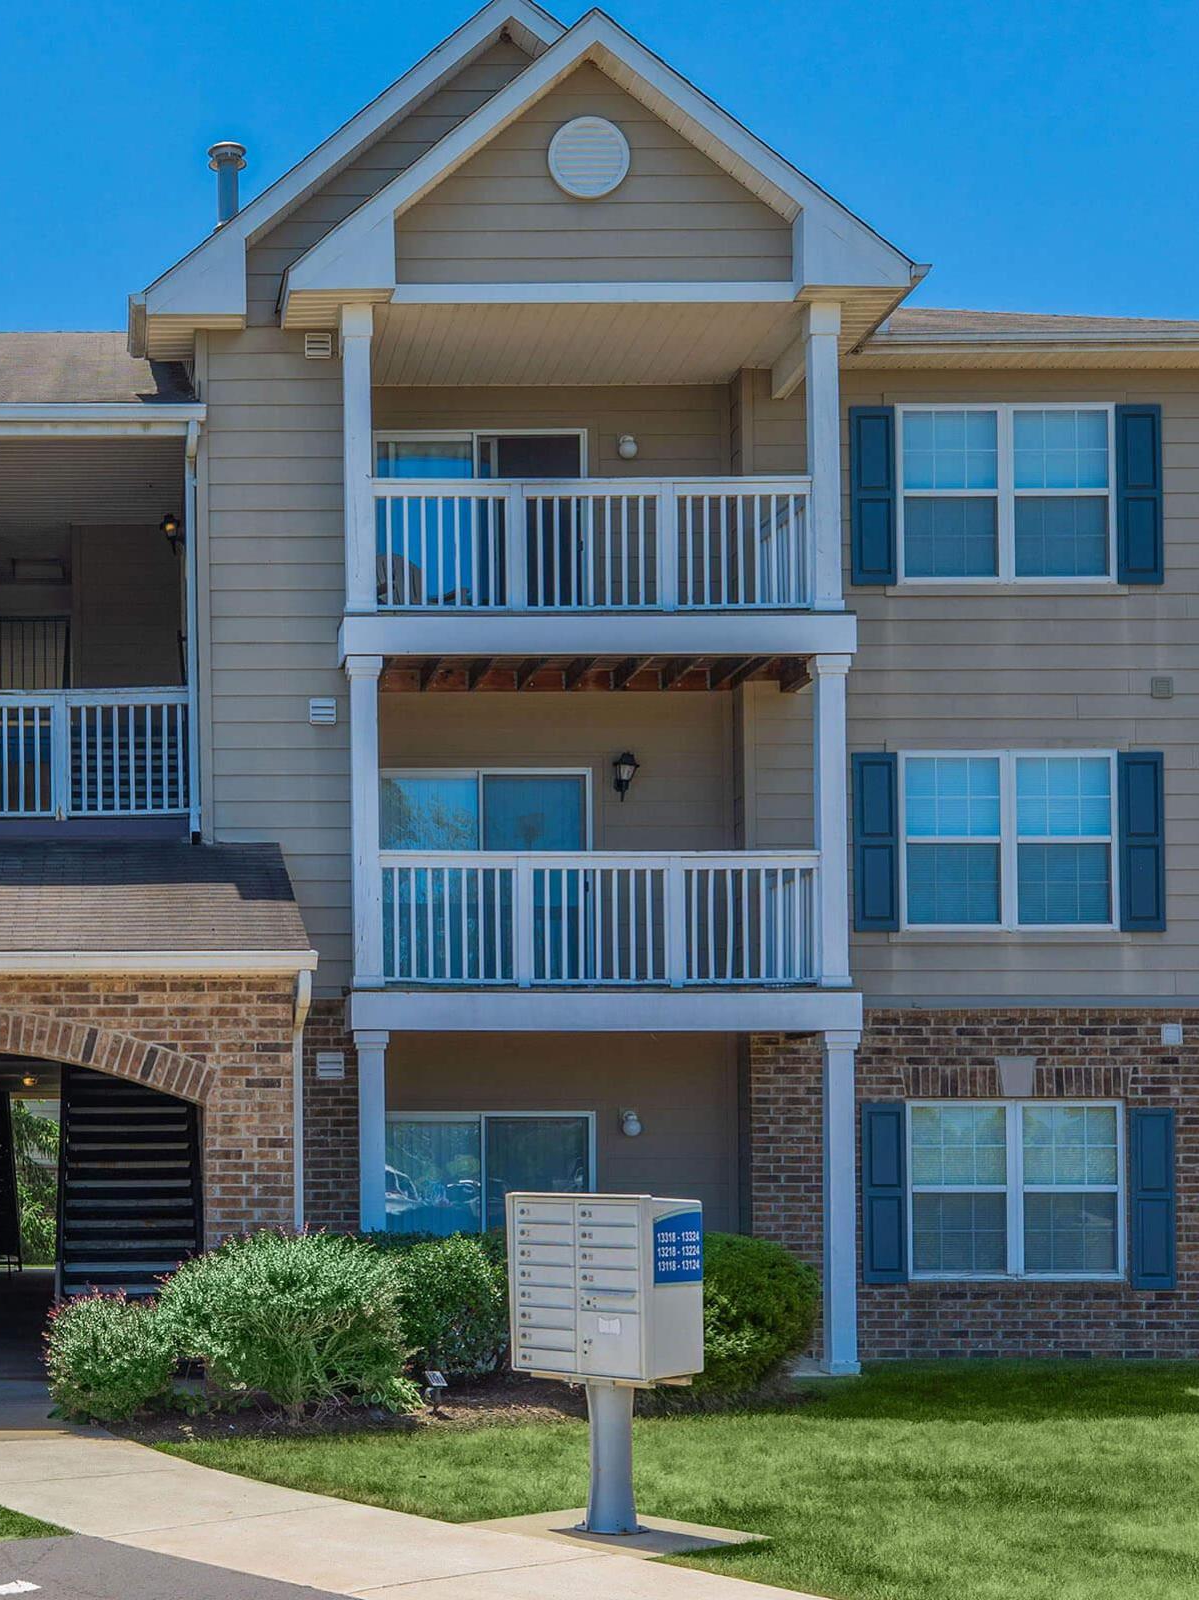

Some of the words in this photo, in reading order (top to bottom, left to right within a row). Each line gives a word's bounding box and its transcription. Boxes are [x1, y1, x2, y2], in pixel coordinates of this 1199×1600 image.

[657, 1232, 676, 1243] 13318
[681, 1231, 700, 1242] 13324
[657, 1246, 676, 1257] 13218
[681, 1245, 700, 1256] 13224
[658, 1260, 676, 1271] 13118
[681, 1259, 700, 1270] 13124
